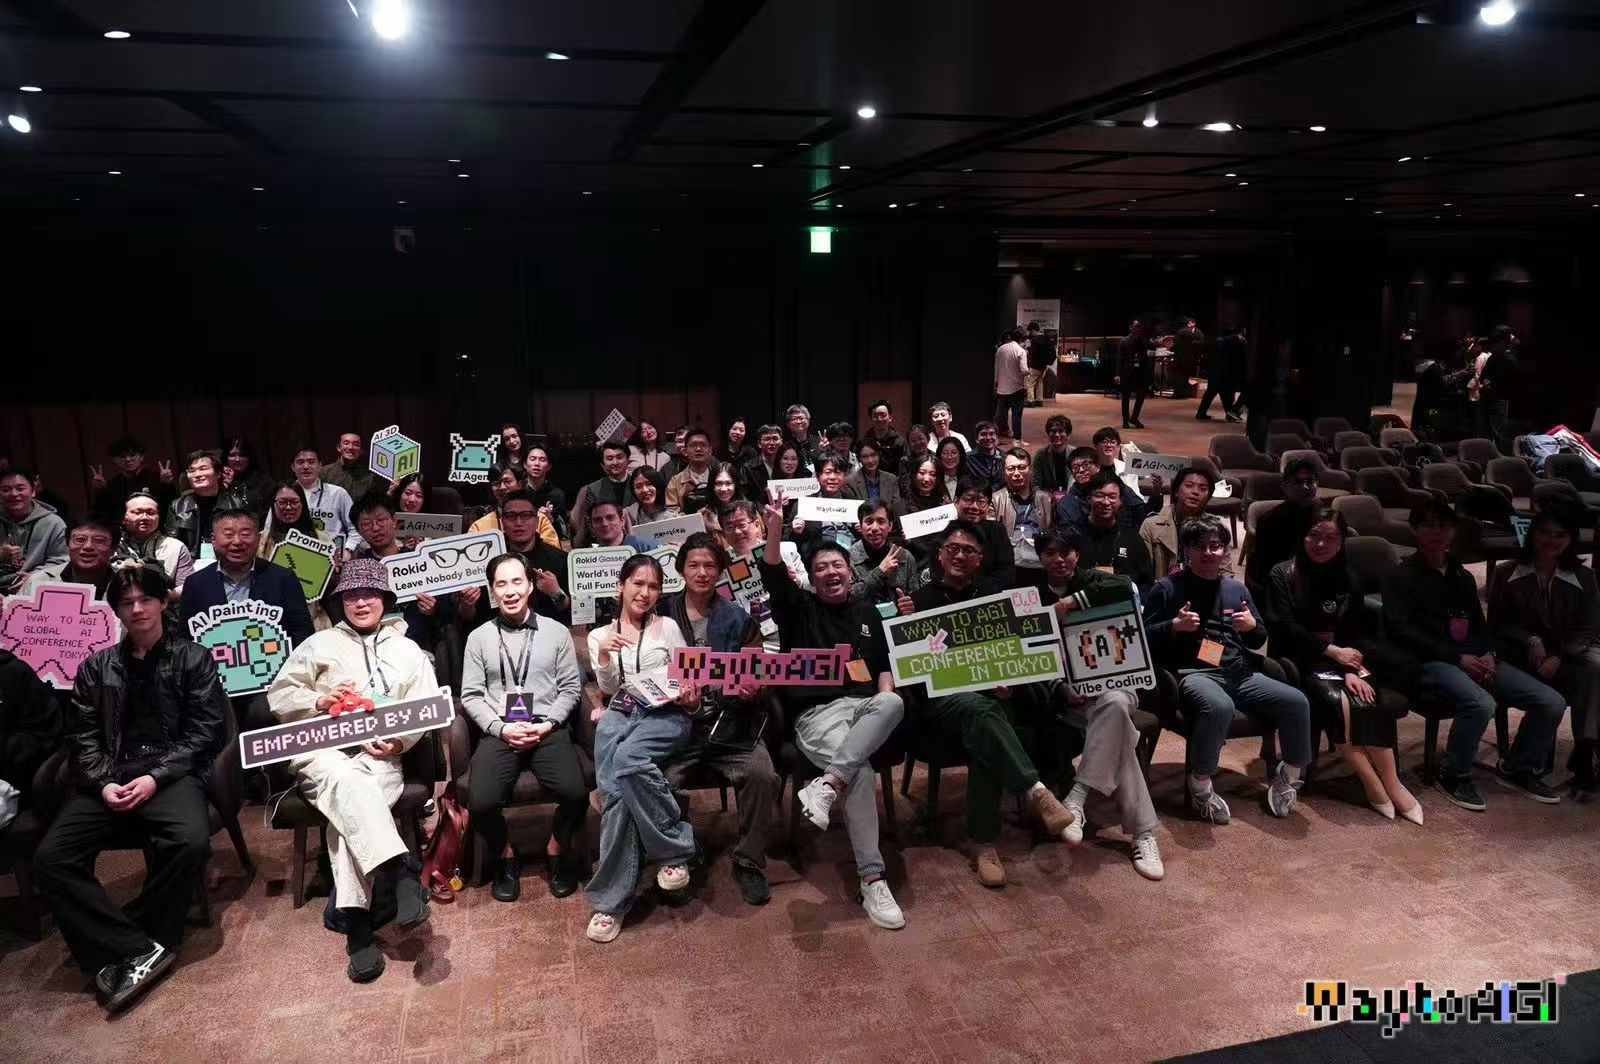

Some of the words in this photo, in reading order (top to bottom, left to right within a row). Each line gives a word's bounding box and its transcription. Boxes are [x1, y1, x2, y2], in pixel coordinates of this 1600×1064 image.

[374, 432, 383, 440] AI
[385, 427, 397, 436] 3D
[450, 472, 461, 480] AI
[463, 472, 488, 482] Agen
[310, 509, 334, 518] ideo
[406, 520, 454, 532] AGIへの道
[288, 531, 333, 553] Prompt
[576, 556, 597, 564] Rokid
[598, 555, 626, 563] Glasses
[392, 561, 427, 577] Rokid
[576, 569, 608, 578] World's
[395, 579, 423, 591] Leave
[426, 570, 463, 585] Nobody
[465, 564, 486, 577] Behi
[577, 581, 593, 590] Full
[26, 614, 50, 622] WAY
[60, 616, 73, 624] TO
[79, 617, 97, 626] AGI
[191, 615, 208, 632] AI
[212, 602, 280, 620] painting
[901, 617, 941, 640] WAY
[947, 611, 971, 629] TO
[976, 602, 1008, 623] AGI
[24, 625, 60, 635] GLOBAL
[80, 629, 93, 637] AI
[951, 622, 1017, 644] GLOBAL
[1022, 617, 1042, 635] AI
[21, 637, 84, 648] CONFERENCE
[20, 648, 33, 657] IN
[910, 640, 1018, 675] CONFERENCE
[679, 653, 840, 689] WaytoAGI
[969, 663, 990, 682] IN
[994, 655, 1052, 678] TOKYO
[1072, 683, 1102, 695] Vibe
[1105, 675, 1153, 690] Coding
[252, 715, 378, 757] EMPOWERED
[384, 710, 411, 729] BY
[418, 703, 439, 721] AI
